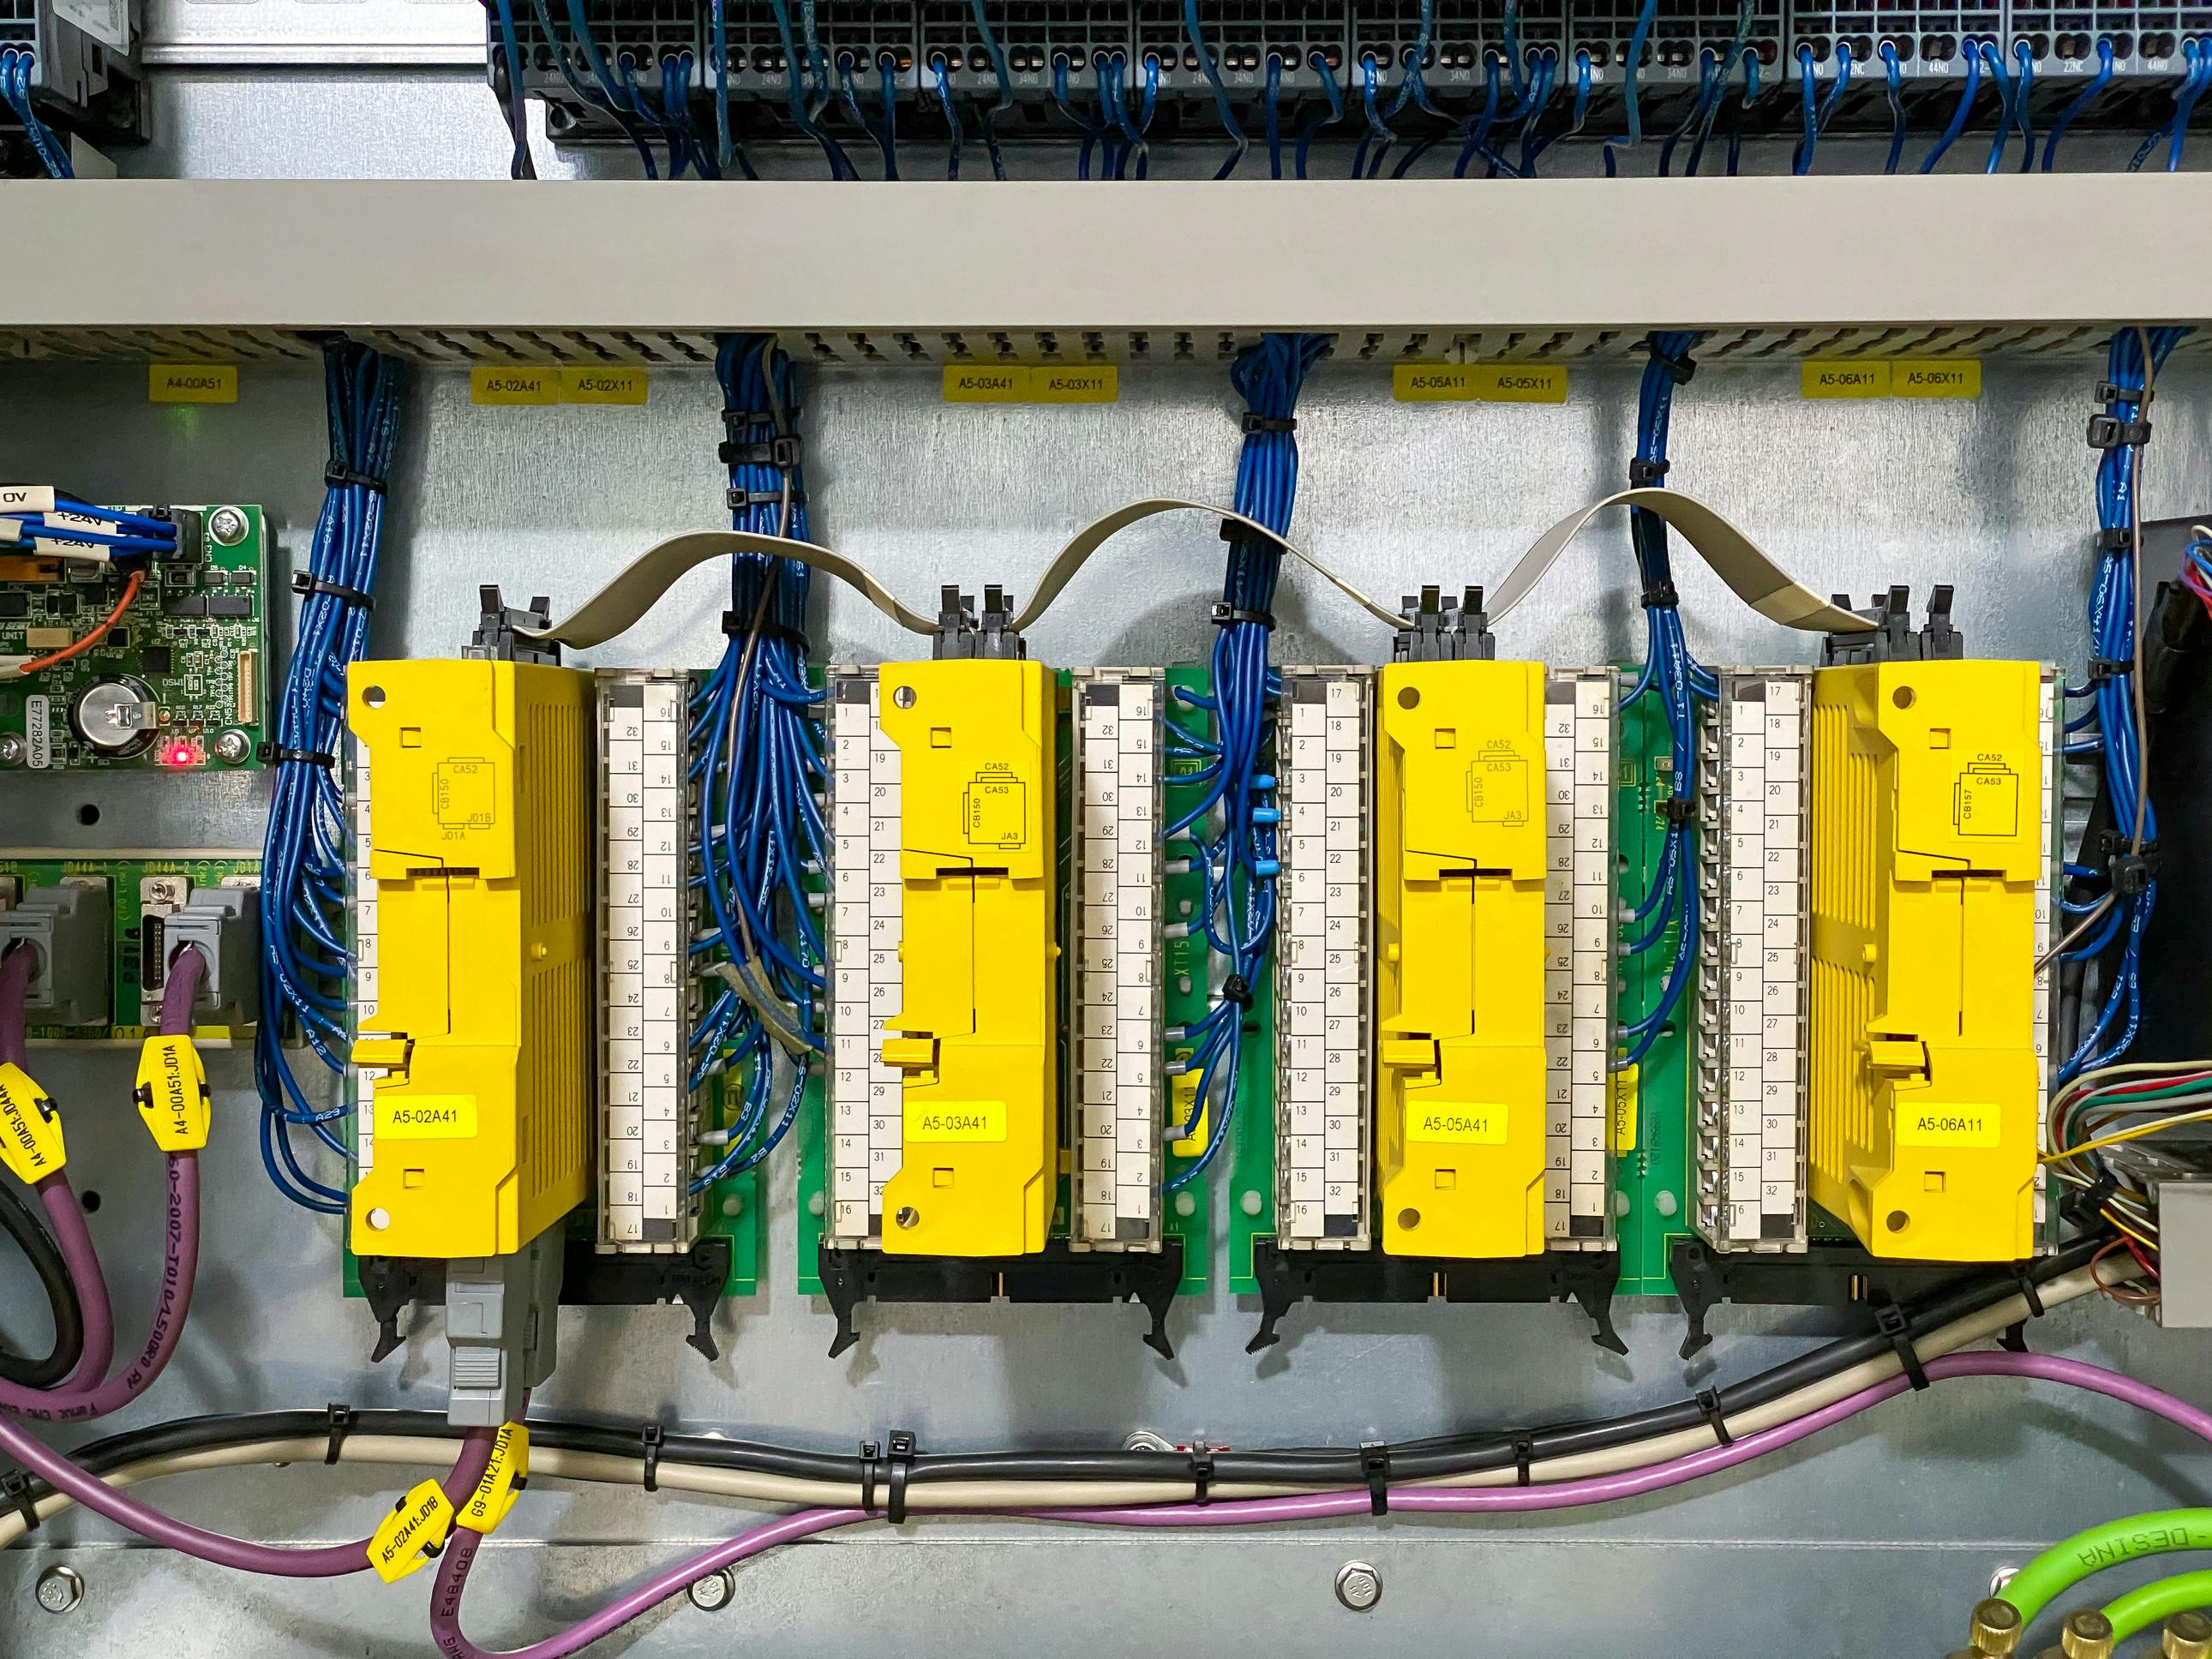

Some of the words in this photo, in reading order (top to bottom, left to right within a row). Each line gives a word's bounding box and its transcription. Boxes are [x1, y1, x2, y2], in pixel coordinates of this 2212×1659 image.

[1928, 61, 1949, 74] 44NO
[2064, 61, 2083, 73] 22NC
[959, 377, 1013, 390] A5-03A41
[1411, 376, 1466, 389] A5-05A11
[1497, 377, 1552, 390] A5-05X11
[1819, 373, 1874, 385] A5-06A11
[1908, 372, 1963, 385] A5-06X11
[486, 380, 541, 392] A5-02A41
[578, 379, 632, 392] A5-02X11
[1049, 379, 1103, 391] A5-03X11
[2, 632, 25, 640] UNIT
[162, 678, 183, 686] DSW1
[1331, 687, 1342, 698] 17
[1770, 686, 1781, 697] 17
[1330, 720, 1342, 731] 18
[1769, 717, 1781, 729] 18
[30, 699, 43, 768] E77282A05
[842, 739, 849, 750] 2
[1298, 739, 1306, 751] 2
[1486, 740, 1511, 750] CA52
[1737, 737, 1745, 748] 2
[874, 752, 886, 764] 19
[1331, 752, 1342, 764] 19
[1769, 750, 1781, 762] 19
[1977, 753, 2003, 762] CA52
[453, 764, 477, 775] CA52
[985, 762, 1010, 771] CA52
[1486, 764, 1511, 773] CA53
[842, 773, 849, 783] 3
[1298, 773, 1305, 784] 3
[1737, 770, 1744, 782] 3
[1976, 777, 2002, 786] CA53
[440, 778, 449, 810] CB150
[873, 786, 886, 798] 20
[985, 786, 1010, 794] CA53
[1330, 786, 1343, 798] 20
[1474, 776, 1484, 807] CB150
[1769, 784, 1781, 795] 20
[1737, 804, 1743, 814] 4
[1963, 789, 1972, 820] CB157
[842, 806, 849, 816] 4
[973, 798, 981, 829] CB150
[1298, 806, 1305, 817] 4
[1503, 811, 1522, 820] JA3
[467, 813, 491, 823] JD1B
[873, 820, 884, 831] 21
[1330, 820, 1340, 832] 21
[1768, 818, 1779, 830] 21
[441, 831, 465, 841] JD1A
[1001, 832, 1018, 841] JA3
[842, 839, 849, 850] 5
[1298, 839, 1305, 850] 5
[1737, 837, 1744, 848] 5
[873, 853, 885, 864] 22
[1329, 853, 1342, 864] 22
[1767, 851, 1780, 862] 22
[842, 871, 849, 883] 6
[1298, 871, 1305, 883] 6
[1736, 870, 1743, 881] 6
[873, 886, 885, 897] 23
[1329, 886, 1342, 897] 23
[1767, 884, 1780, 895] 23
[364, 905, 371, 915] 7
[842, 907, 848, 917] 7
[1298, 907, 1304, 918] 7
[1735, 905, 1742, 916] 7
[873, 919, 885, 931] 24
[1329, 919, 1341, 931] 24
[1767, 918, 1779, 929] 24
[1766, 951, 1779, 962] 25
[365, 972, 372, 982] 9
[842, 973, 848, 984] 9
[1298, 973, 1304, 984] 9
[363, 1004, 375, 1015] 10
[840, 1005, 852, 1016] 10
[1296, 1005, 1308, 1016] 10
[1297, 1039, 1306, 1050] 11
[363, 1070, 375, 1081] 12
[162, 1045, 189, 1135] A4-00A51:JD1A
[315, 1108, 340, 1122] A29
[393, 1110, 458, 1124] A5-02A41
[922, 1116, 987, 1130] A5-03A41
[1424, 1117, 1489, 1132] A5-05A41
[1917, 1117, 1982, 1131] A5-06A11
[471, 1428, 514, 1518] G9-01A21:JD1A
[381, 1495, 439, 1565] A5-02A41:JD1B
[2077, 1527, 2191, 1567] DESINA
